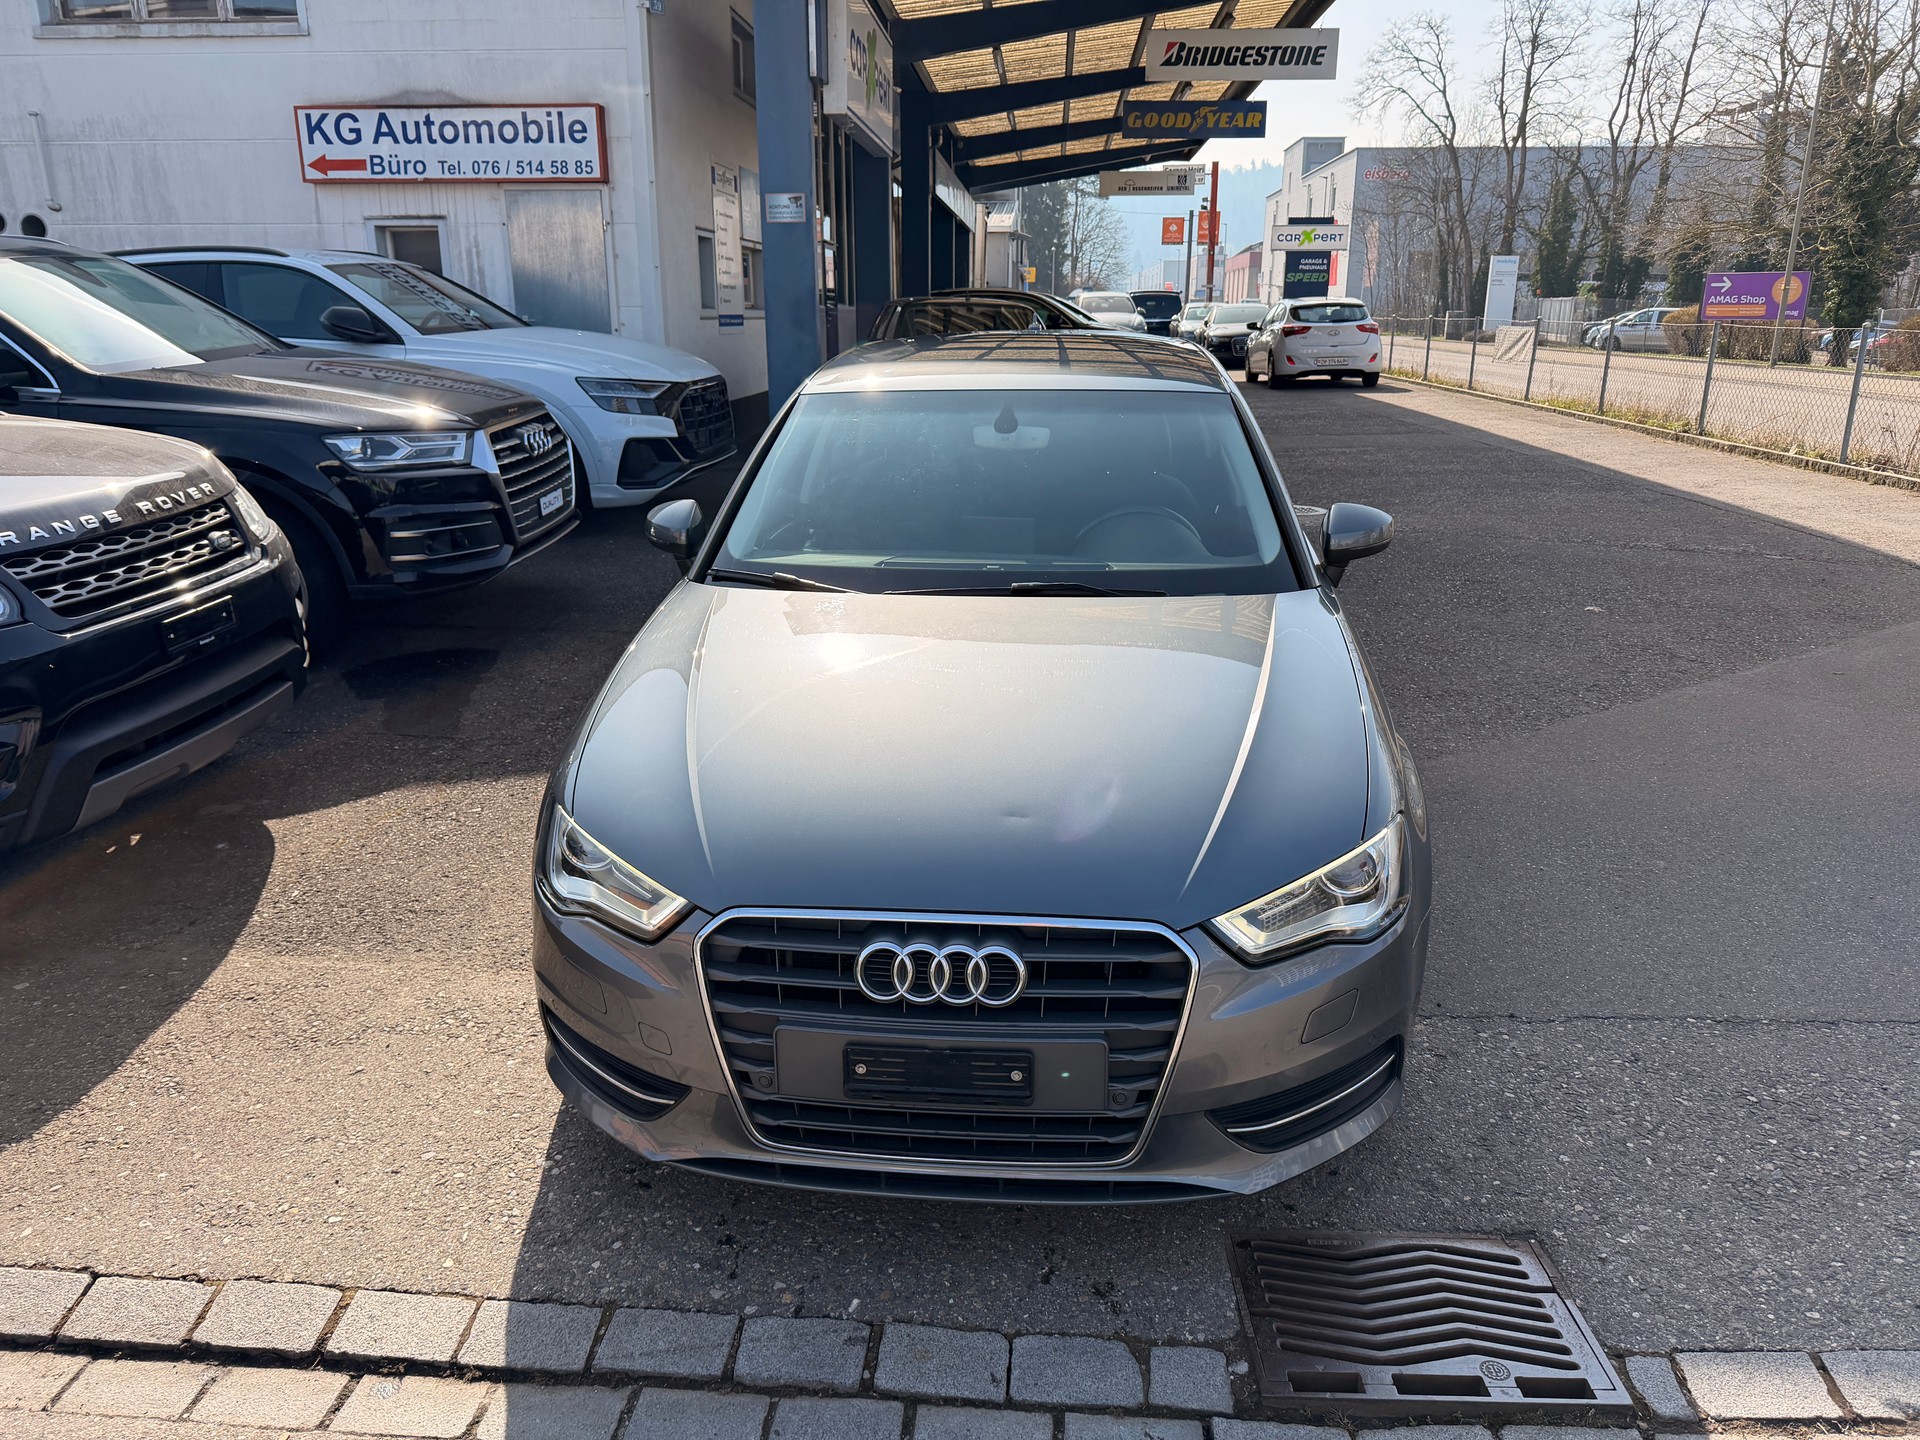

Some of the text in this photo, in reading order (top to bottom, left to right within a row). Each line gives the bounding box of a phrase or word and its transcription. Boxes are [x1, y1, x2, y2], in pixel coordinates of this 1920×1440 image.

[1159, 41, 1328, 67] BRIDGESTONE
[304, 111, 588, 145] KG Automobile
[369, 155, 426, 176] Büro
[437, 160, 466, 175] Tel.
[472, 160, 500, 175] 076
[516, 160, 544, 175] 514
[550, 160, 569, 175] 58
[574, 160, 593, 175] 85
[1286, 272, 1329, 282] SPEED
[1708, 295, 1766, 305] AMAG Shop
[0, 482, 216, 547] RANGE ROVER
